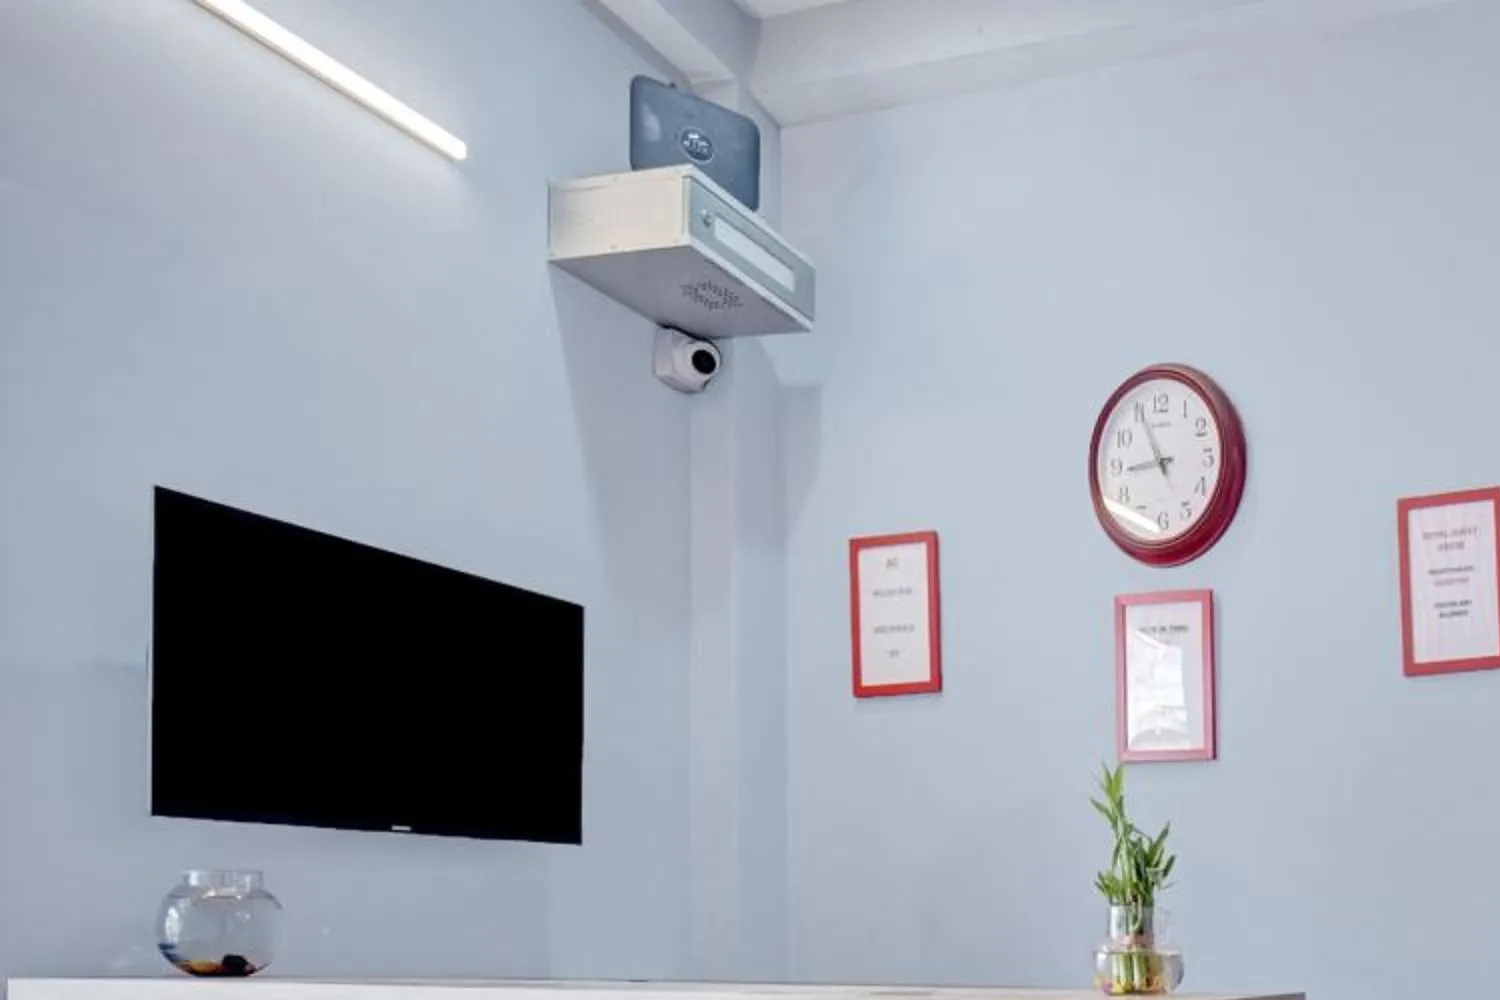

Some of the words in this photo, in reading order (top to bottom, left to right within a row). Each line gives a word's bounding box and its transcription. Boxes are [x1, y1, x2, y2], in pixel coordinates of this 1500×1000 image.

[1153, 393, 1169, 413] 12
[1194, 417, 1208, 437] 2
[1117, 428, 1133, 449] 10
[1110, 458, 1123, 476] 9
[1202, 447, 1215, 468] 3
[1194, 476, 1206, 497] 4
[1157, 512, 1170, 531] 6
